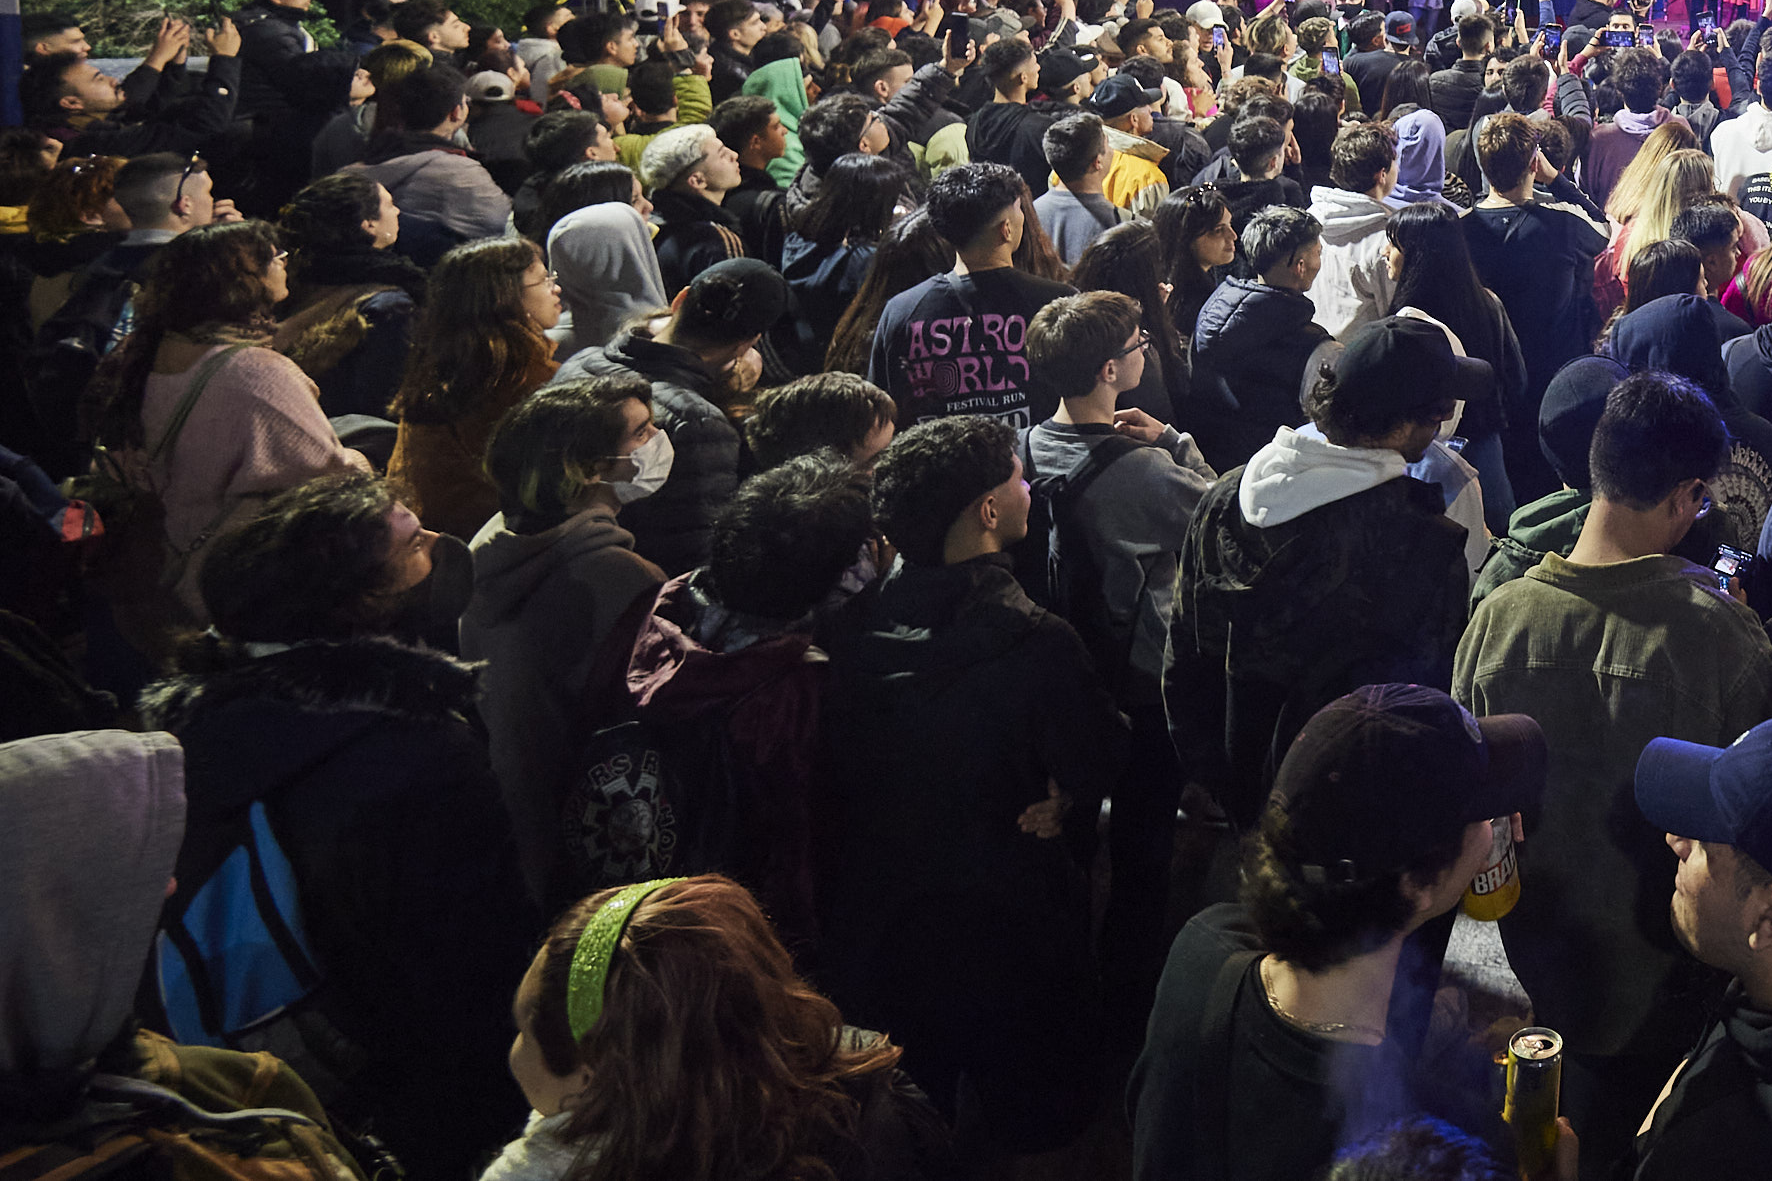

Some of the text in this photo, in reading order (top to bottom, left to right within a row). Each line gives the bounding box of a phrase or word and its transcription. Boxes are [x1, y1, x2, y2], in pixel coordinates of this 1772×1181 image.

[1749, 196, 1772, 205] YOU BY
[908, 314, 1027, 359] ASTRO
[907, 355, 1030, 398] WORLD
[946, 392, 1027, 412] FESTIVAL RUN
